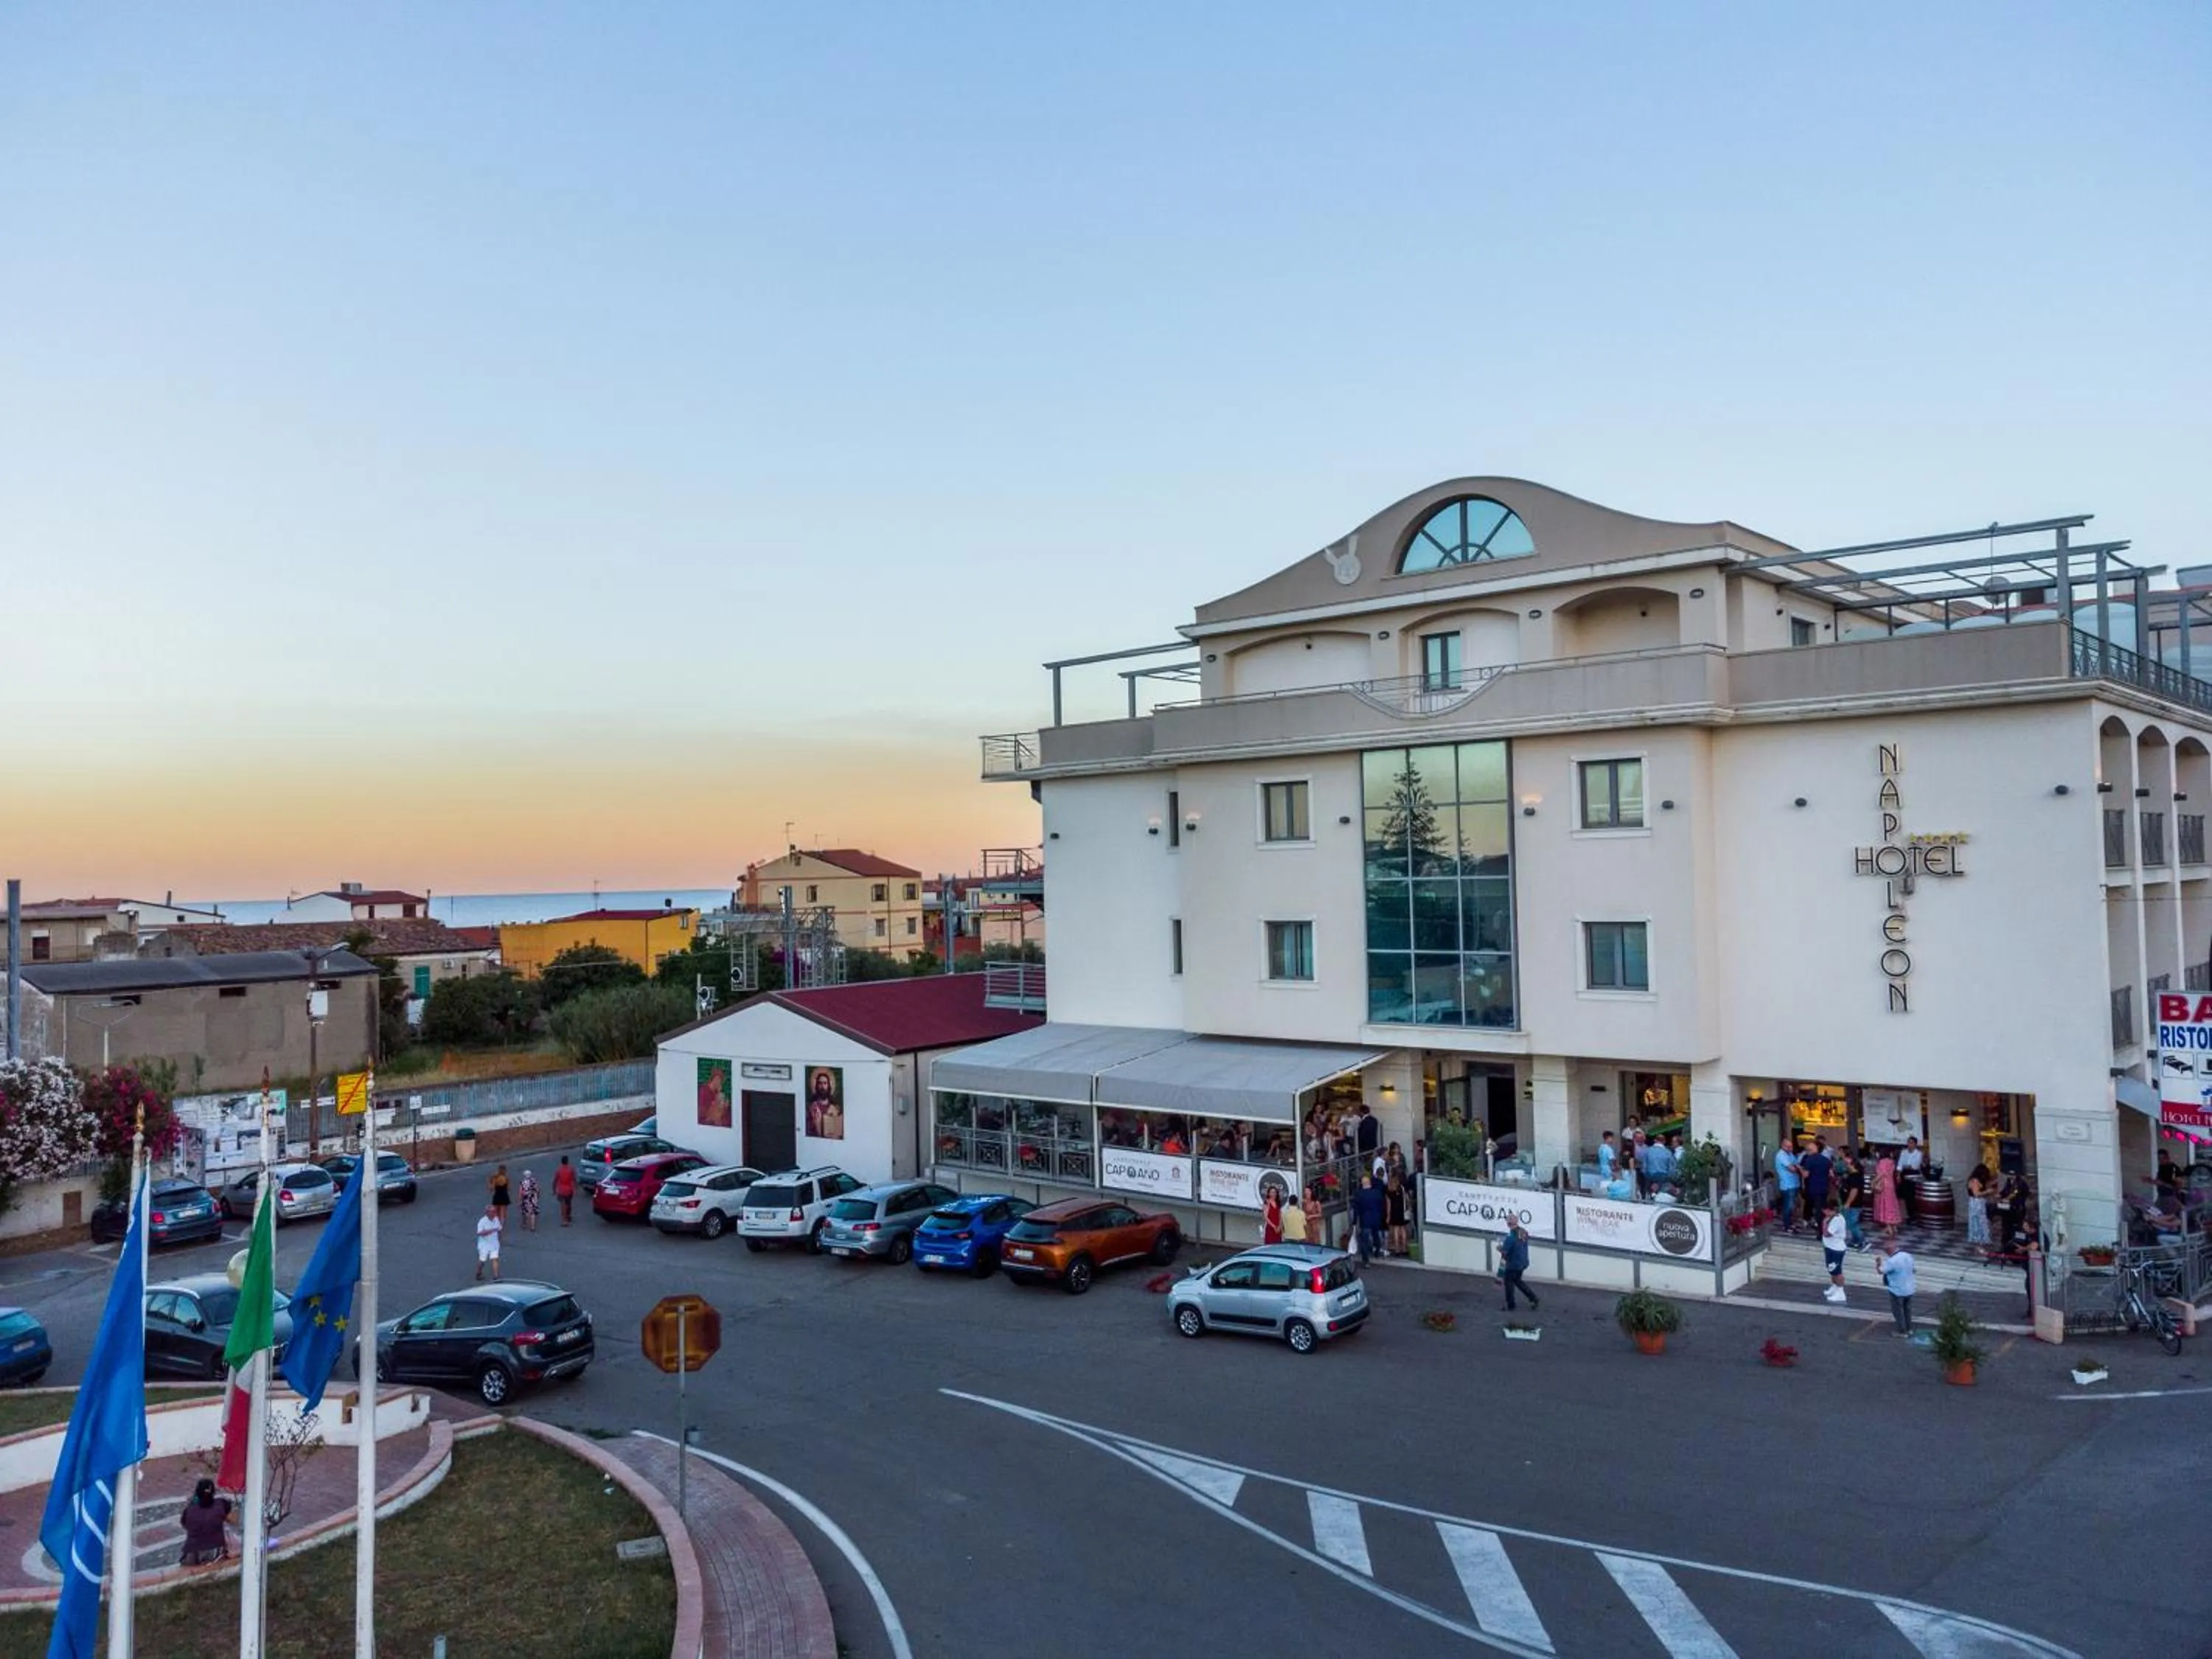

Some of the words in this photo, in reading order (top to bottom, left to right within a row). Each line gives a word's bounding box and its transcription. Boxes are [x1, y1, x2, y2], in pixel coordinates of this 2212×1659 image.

[1854, 846, 1965, 875] HOTEL
[1877, 743, 1911, 1012] NAPOLEON
[2160, 1025, 2212, 1050] RISTO
[1576, 1206, 1634, 1222] RISTORANTE
[1659, 1229, 1695, 1241] apertura
[1663, 1221, 1690, 1232] nuova
